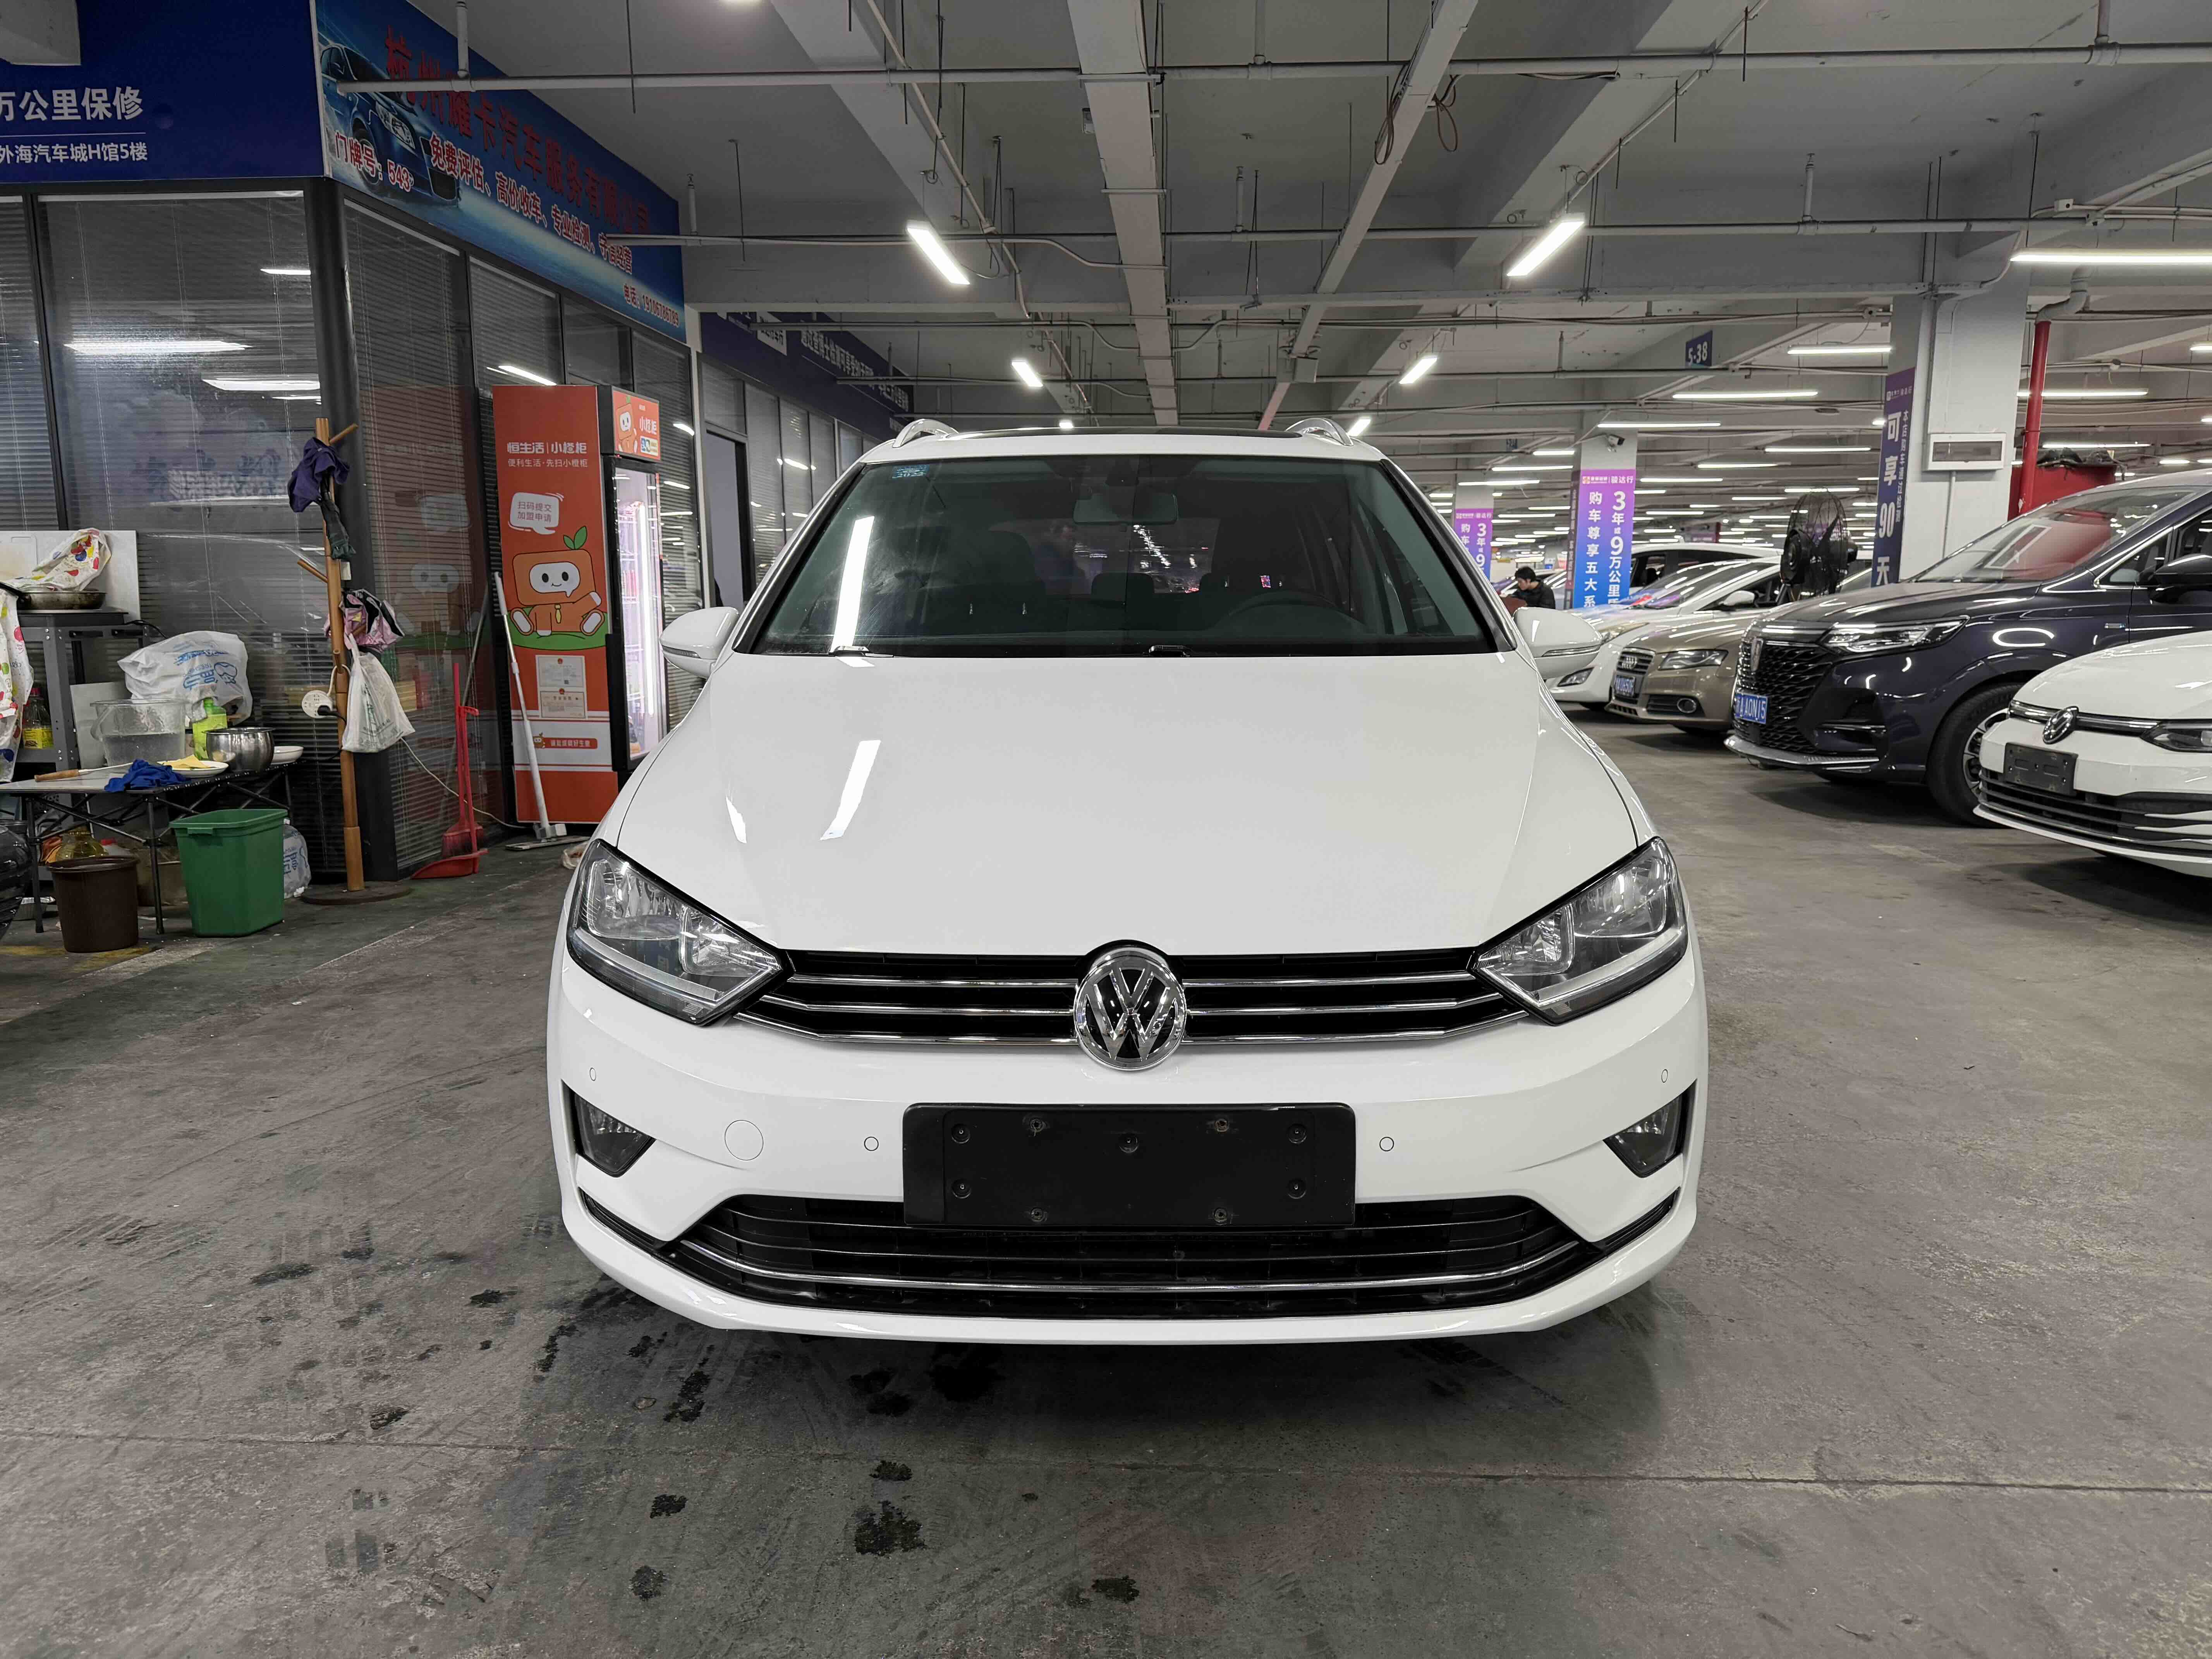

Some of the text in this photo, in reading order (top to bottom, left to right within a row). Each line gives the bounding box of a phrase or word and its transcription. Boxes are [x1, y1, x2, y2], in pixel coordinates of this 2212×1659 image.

[507, 441, 587, 454] 恒生活 小橙柜
